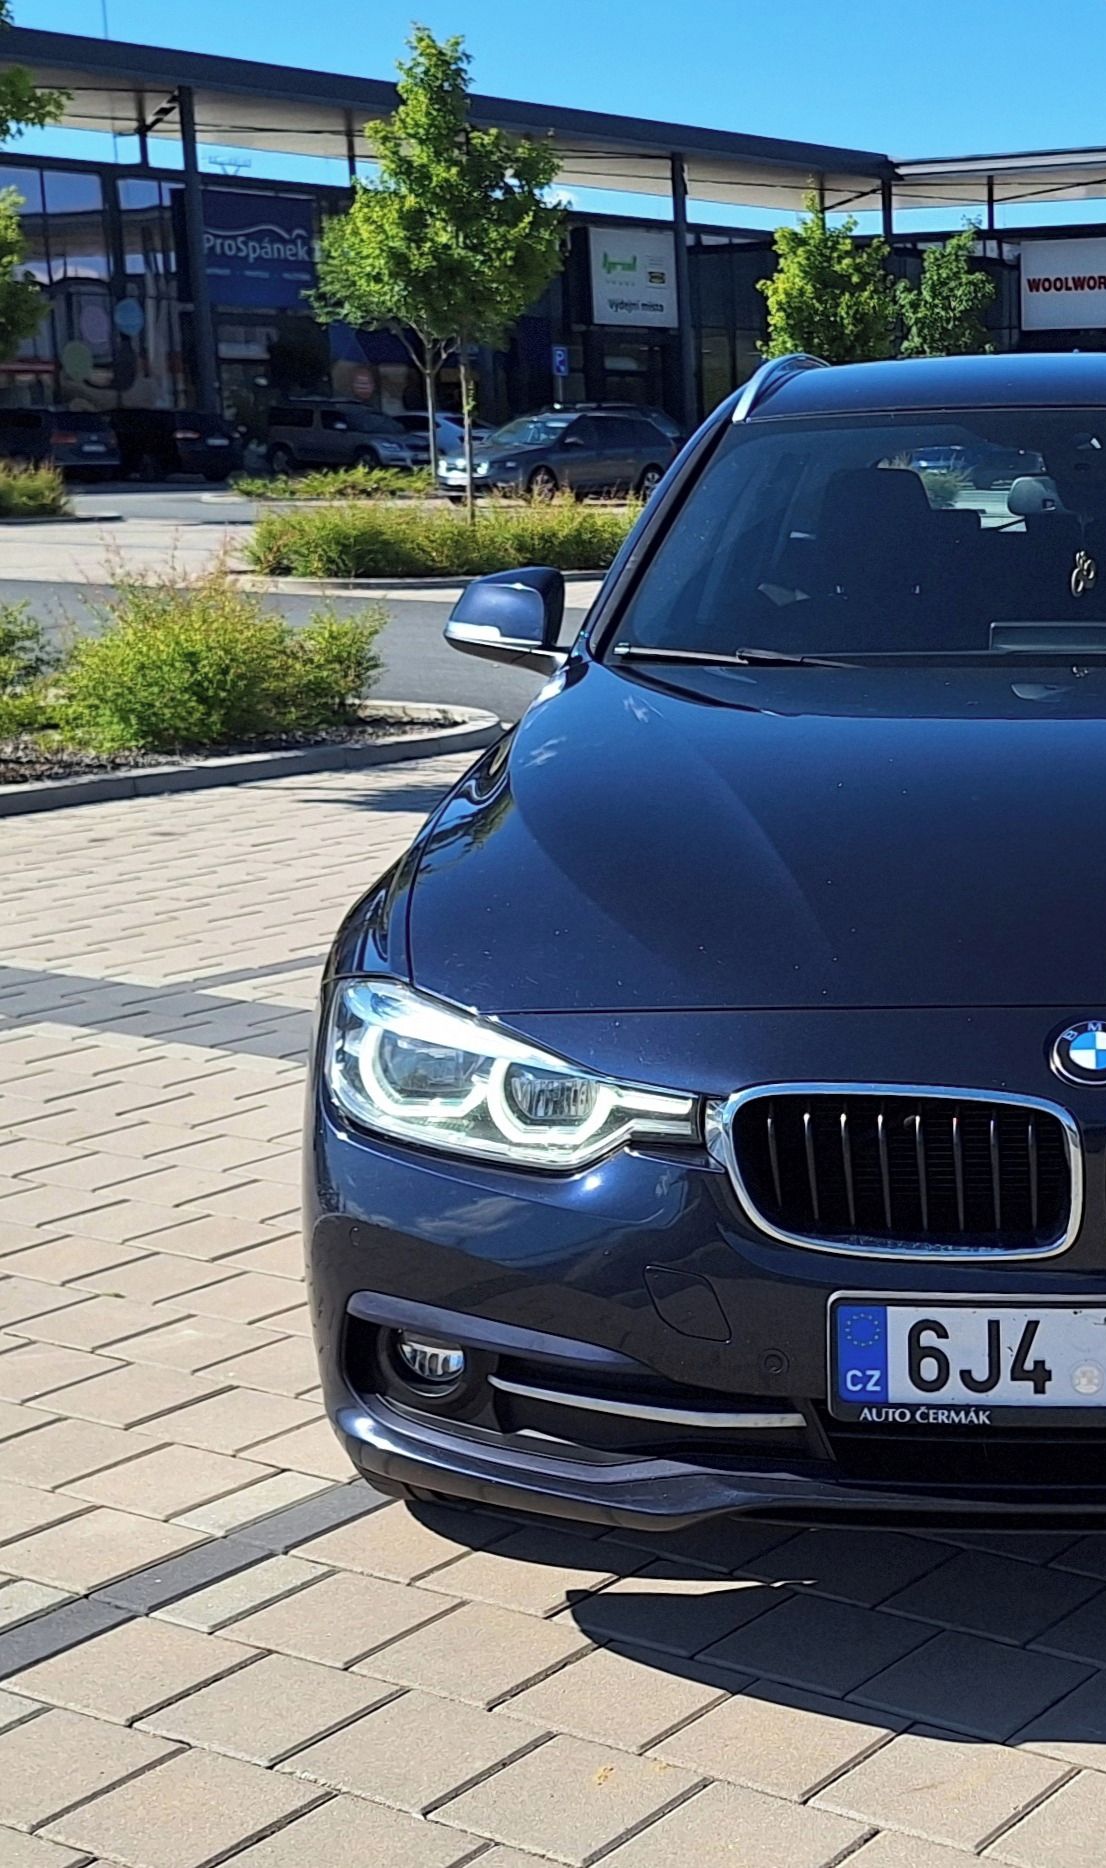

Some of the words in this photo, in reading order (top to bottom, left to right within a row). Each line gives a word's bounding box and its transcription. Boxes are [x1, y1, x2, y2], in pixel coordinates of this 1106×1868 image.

[203, 233, 309, 263] ProSpánek
[908, 1318, 1053, 1395] 6J4
[845, 1369, 882, 1392] CZ
[859, 1407, 911, 1424] AUTO
[915, 1406, 992, 1425] ČERMÁK
